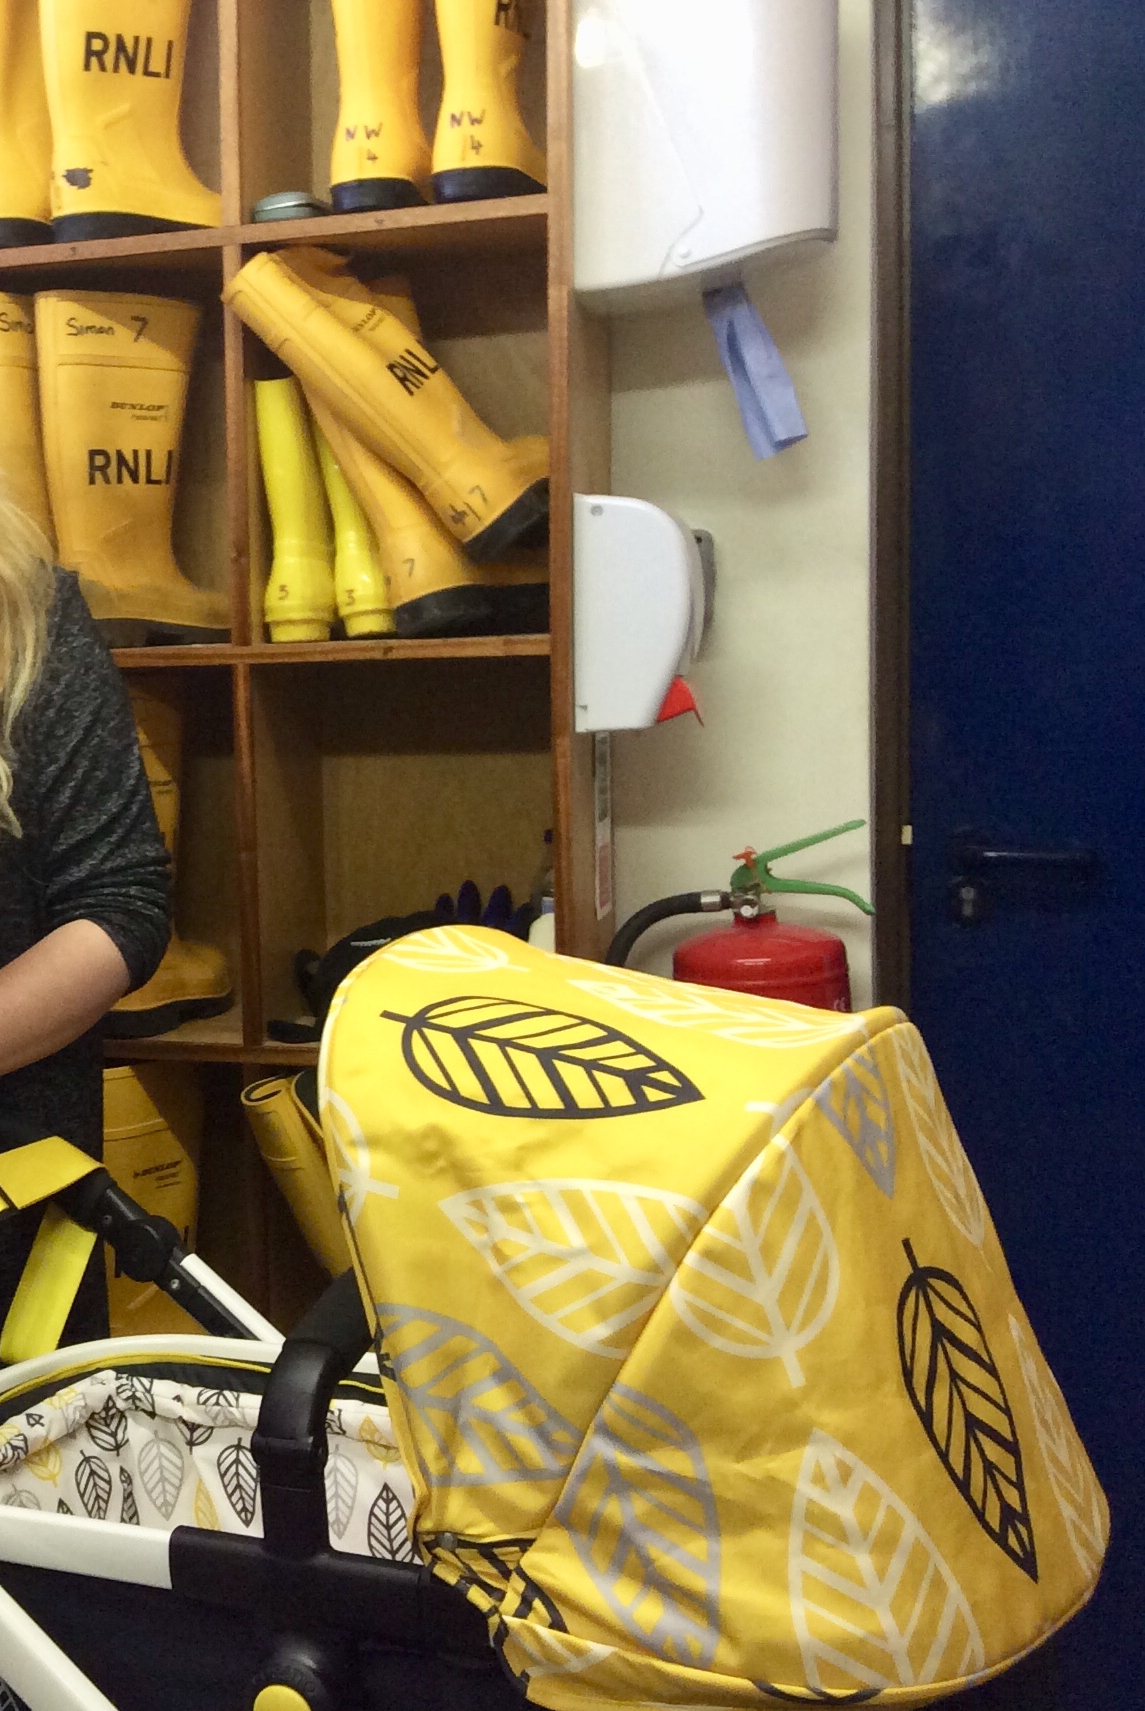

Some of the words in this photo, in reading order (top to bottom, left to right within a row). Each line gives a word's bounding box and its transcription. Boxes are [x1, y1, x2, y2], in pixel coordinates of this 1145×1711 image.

[83, 31, 174, 79] RNLI
[130, 315, 149, 343] 7
[88, 448, 174, 486] RNLI
